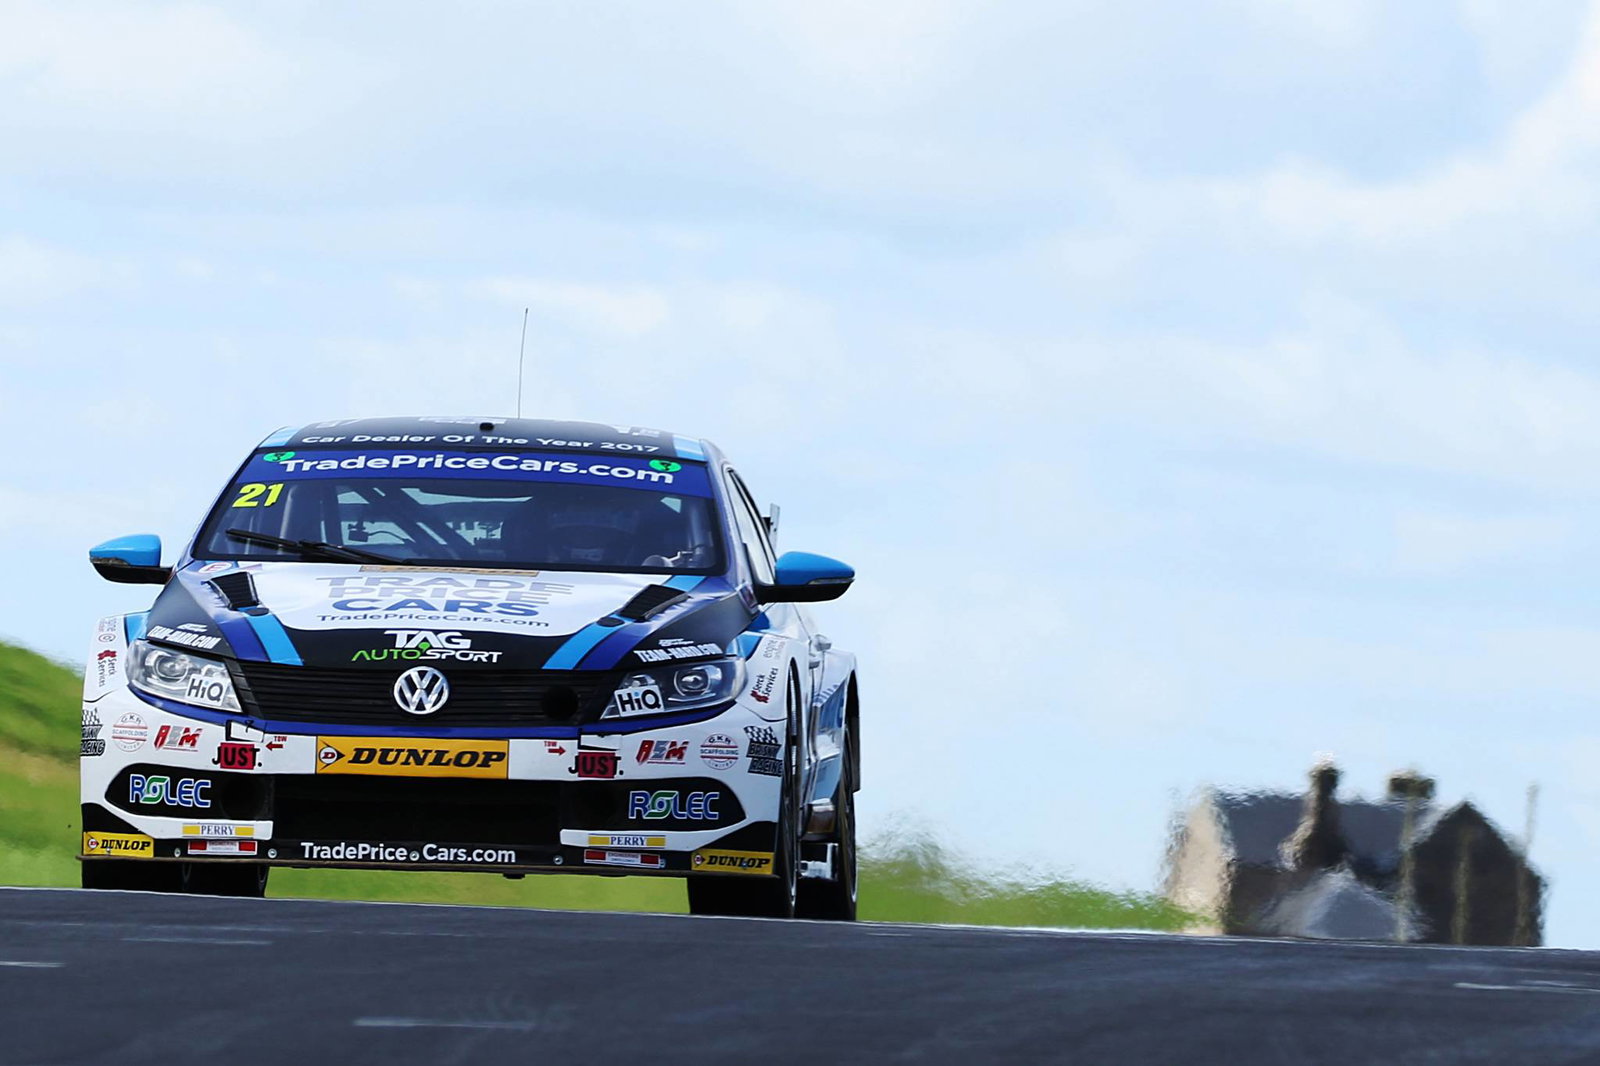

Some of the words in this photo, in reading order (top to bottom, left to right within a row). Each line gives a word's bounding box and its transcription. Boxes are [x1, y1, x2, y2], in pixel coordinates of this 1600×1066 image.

[302, 435, 346, 443] Car
[352, 434, 436, 443] Dealer
[442, 434, 475, 443] Of
[482, 435, 528, 444] The
[536, 438, 594, 447] Year
[601, 442, 660, 452] 2017
[279, 454, 674, 484] TradePriceCars.com
[232, 483, 284, 508] 21
[316, 576, 576, 595] TRADE
[328, 587, 552, 605] PRICE
[332, 599, 539, 617] CARS
[317, 613, 549, 628] TradePriceCars.com
[384, 630, 472, 649] TAG
[187, 677, 224, 702] HiQ
[761, 667, 779, 697] Services
[617, 689, 662, 712] HiQ
[112, 729, 148, 737] SCAFFOLDING
[348, 747, 506, 768] DUNLOP
[700, 748, 739, 756] SCAFFOLDING
[129, 773, 211, 808] ROLEC
[628, 790, 720, 820] ROLEC
[201, 824, 236, 836] PERRY
[100, 838, 151, 852] DUNLOP
[610, 835, 646, 847] PERRY
[300, 842, 407, 861] TradePrice
[422, 843, 516, 863] Cars.com
[707, 855, 771, 869] DUNLOP
